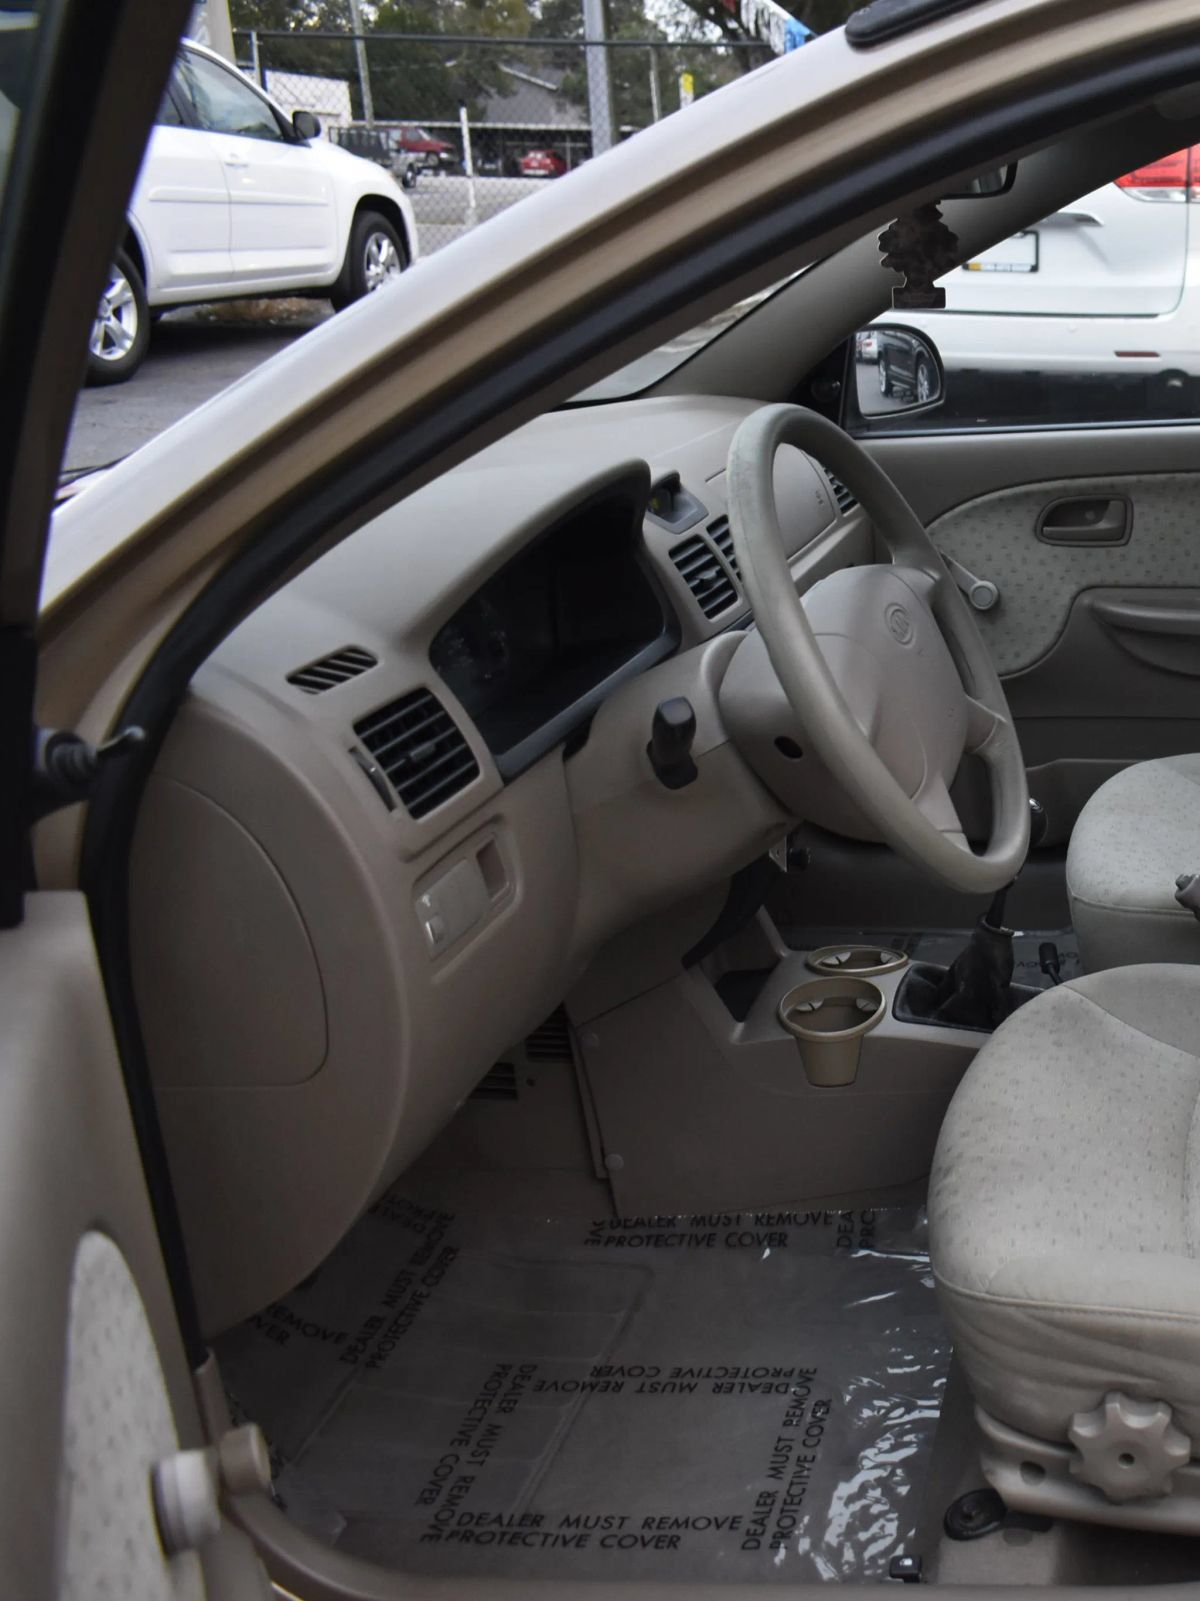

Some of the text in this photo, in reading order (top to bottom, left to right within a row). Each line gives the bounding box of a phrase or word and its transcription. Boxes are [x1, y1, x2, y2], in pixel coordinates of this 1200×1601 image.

[603, 1232, 788, 1248] PROTECTIVE COVER
[607, 1212, 833, 1231] DEALER MUST REMOVE
[339, 1315, 385, 1364] DEALER
[381, 1269, 416, 1310] MUST
[364, 1288, 431, 1369] PROTECTIVE
[534, 1380, 790, 1395] DEALER MUST REMOVE
[590, 1365, 795, 1379] PROTECTIVE COVER
[414, 1363, 513, 1505] PROTECTIVE COVER
[421, 1364, 538, 1543] DEALER MUST REMOVE
[742, 1367, 818, 1551] DEALER MUST REMOVE
[769, 1398, 833, 1551] PROTECTIVE COVER
[445, 1529, 683, 1550] PROTECTIVE COVER
[456, 1512, 743, 1531] DEALER MUST REMOVE
